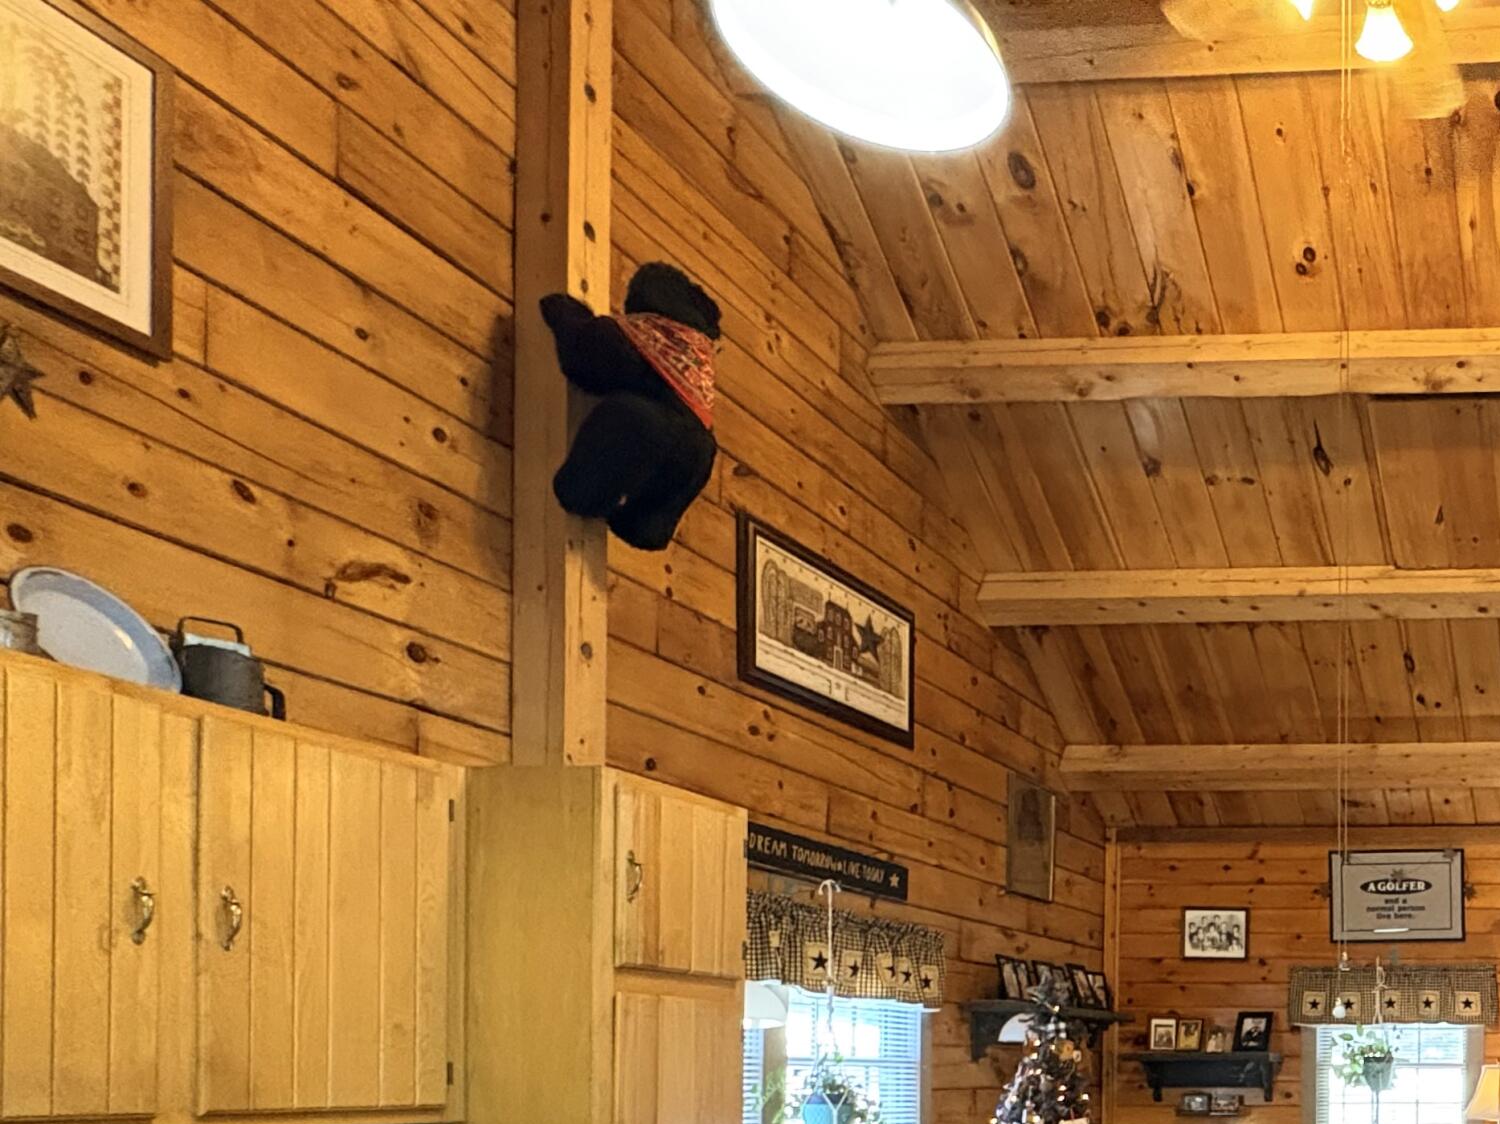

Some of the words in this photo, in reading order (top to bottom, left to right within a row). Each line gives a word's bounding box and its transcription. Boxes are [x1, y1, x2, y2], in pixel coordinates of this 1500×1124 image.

[749, 833, 787, 857] DREAM
[792, 844, 837, 871] TOMORROW
[843, 859, 861, 878] LIVE
[862, 865, 885, 883] TODAY
[1368, 882, 1376, 891] A
[1377, 881, 1426, 891] GOLFER
